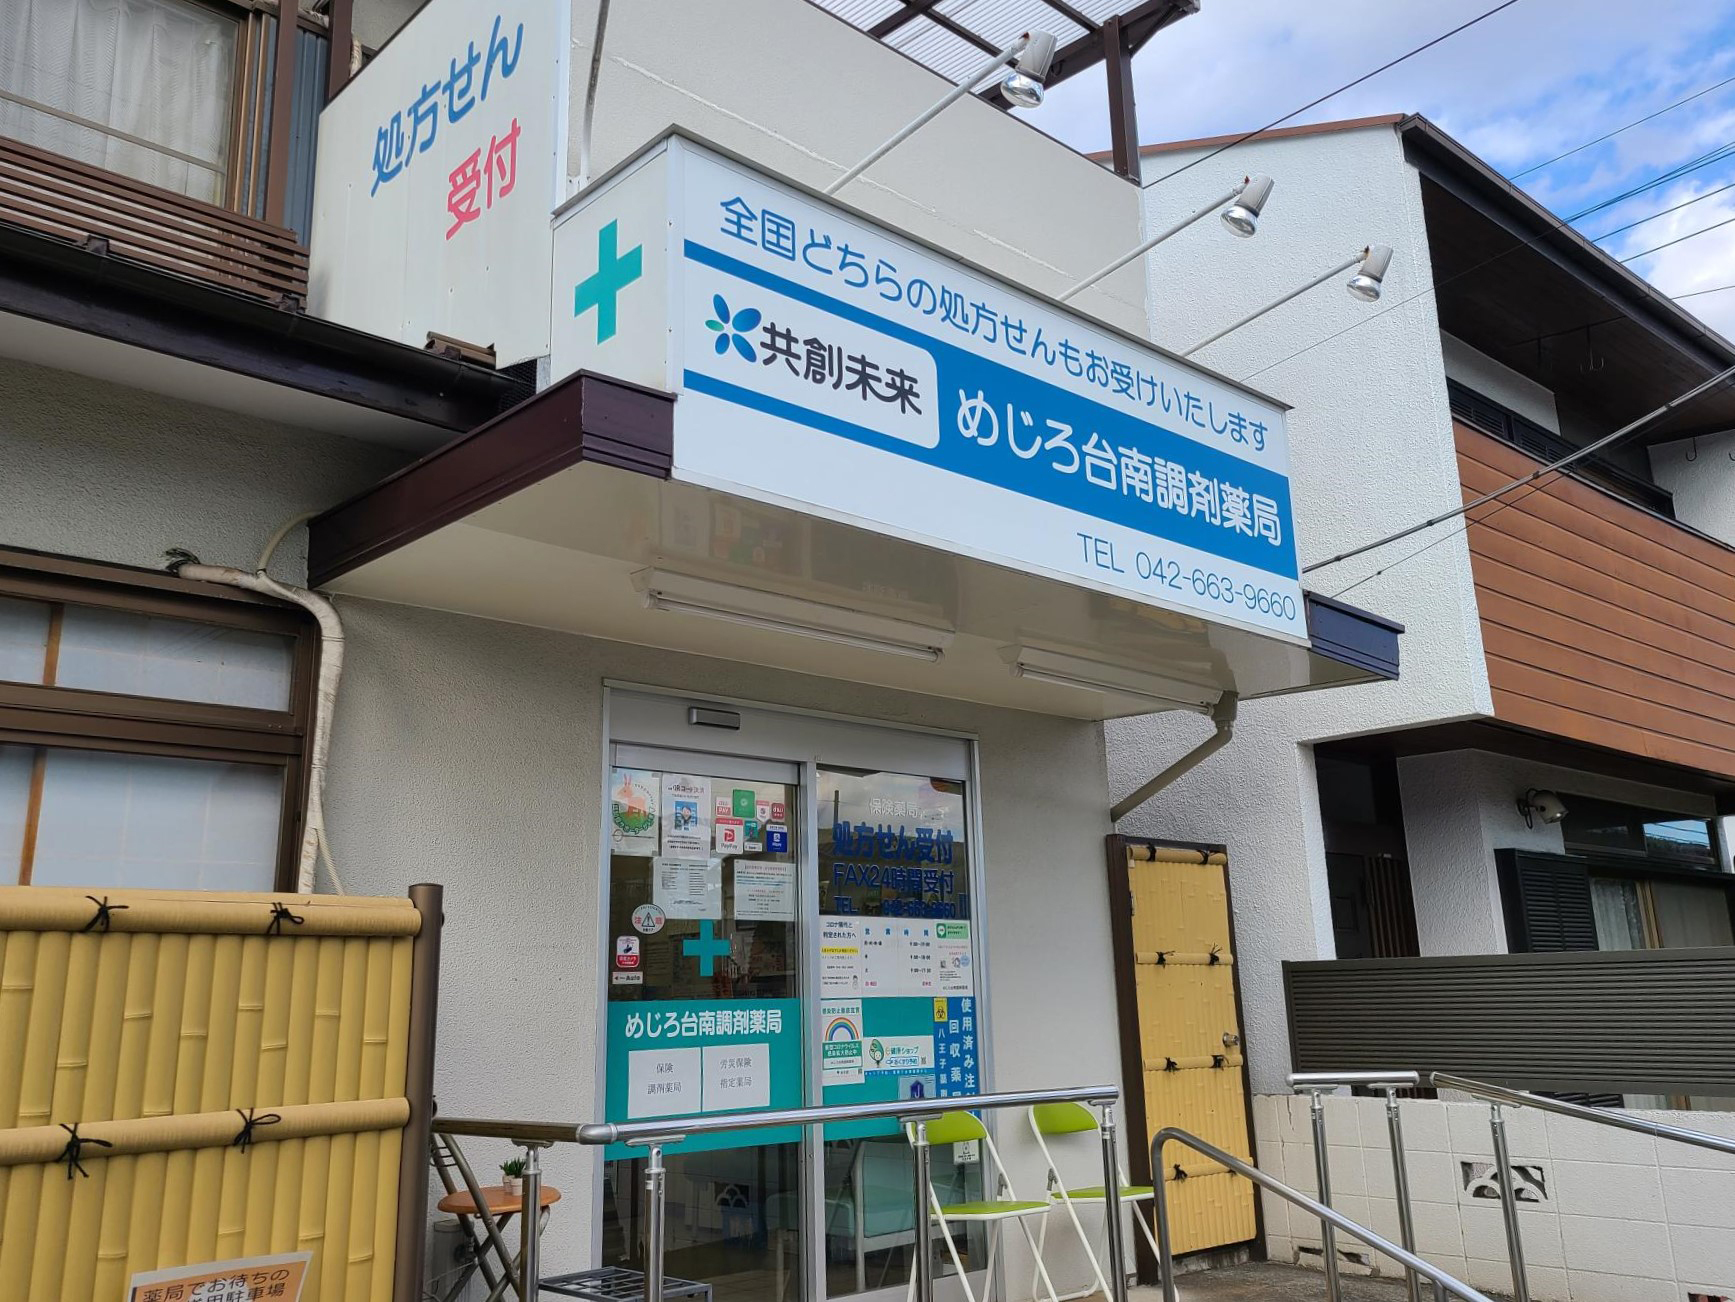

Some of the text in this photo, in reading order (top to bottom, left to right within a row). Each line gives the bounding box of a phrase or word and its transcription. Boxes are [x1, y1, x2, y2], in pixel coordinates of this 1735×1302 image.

[370, 15, 524, 198] 処方せん
[445, 118, 521, 241] 受付
[719, 195, 1268, 452] 全国どちらの処方せんもお受けいたします
[760, 322, 923, 416] 共創未来
[957, 388, 1281, 546] めじろ台南調剤薬局
[1076, 532, 1296, 621] TEL 042-663-9660
[869, 798, 918, 818] 保険薬局
[833, 821, 953, 865] 処方せん受付
[833, 862, 955, 895] FAX24時間受付
[625, 1009, 782, 1039] めじろ台南調剤薬局
[656, 1062, 674, 1074] 保険
[720, 1057, 752, 1070] 労災保険
[647, 1081, 682, 1095] 調剤薬局
[720, 1076, 752, 1089] 指定薬局
[142, 1269, 290, 1302] 薬局でお待ちの
[187, 1282, 286, 1302] 用駐車場
